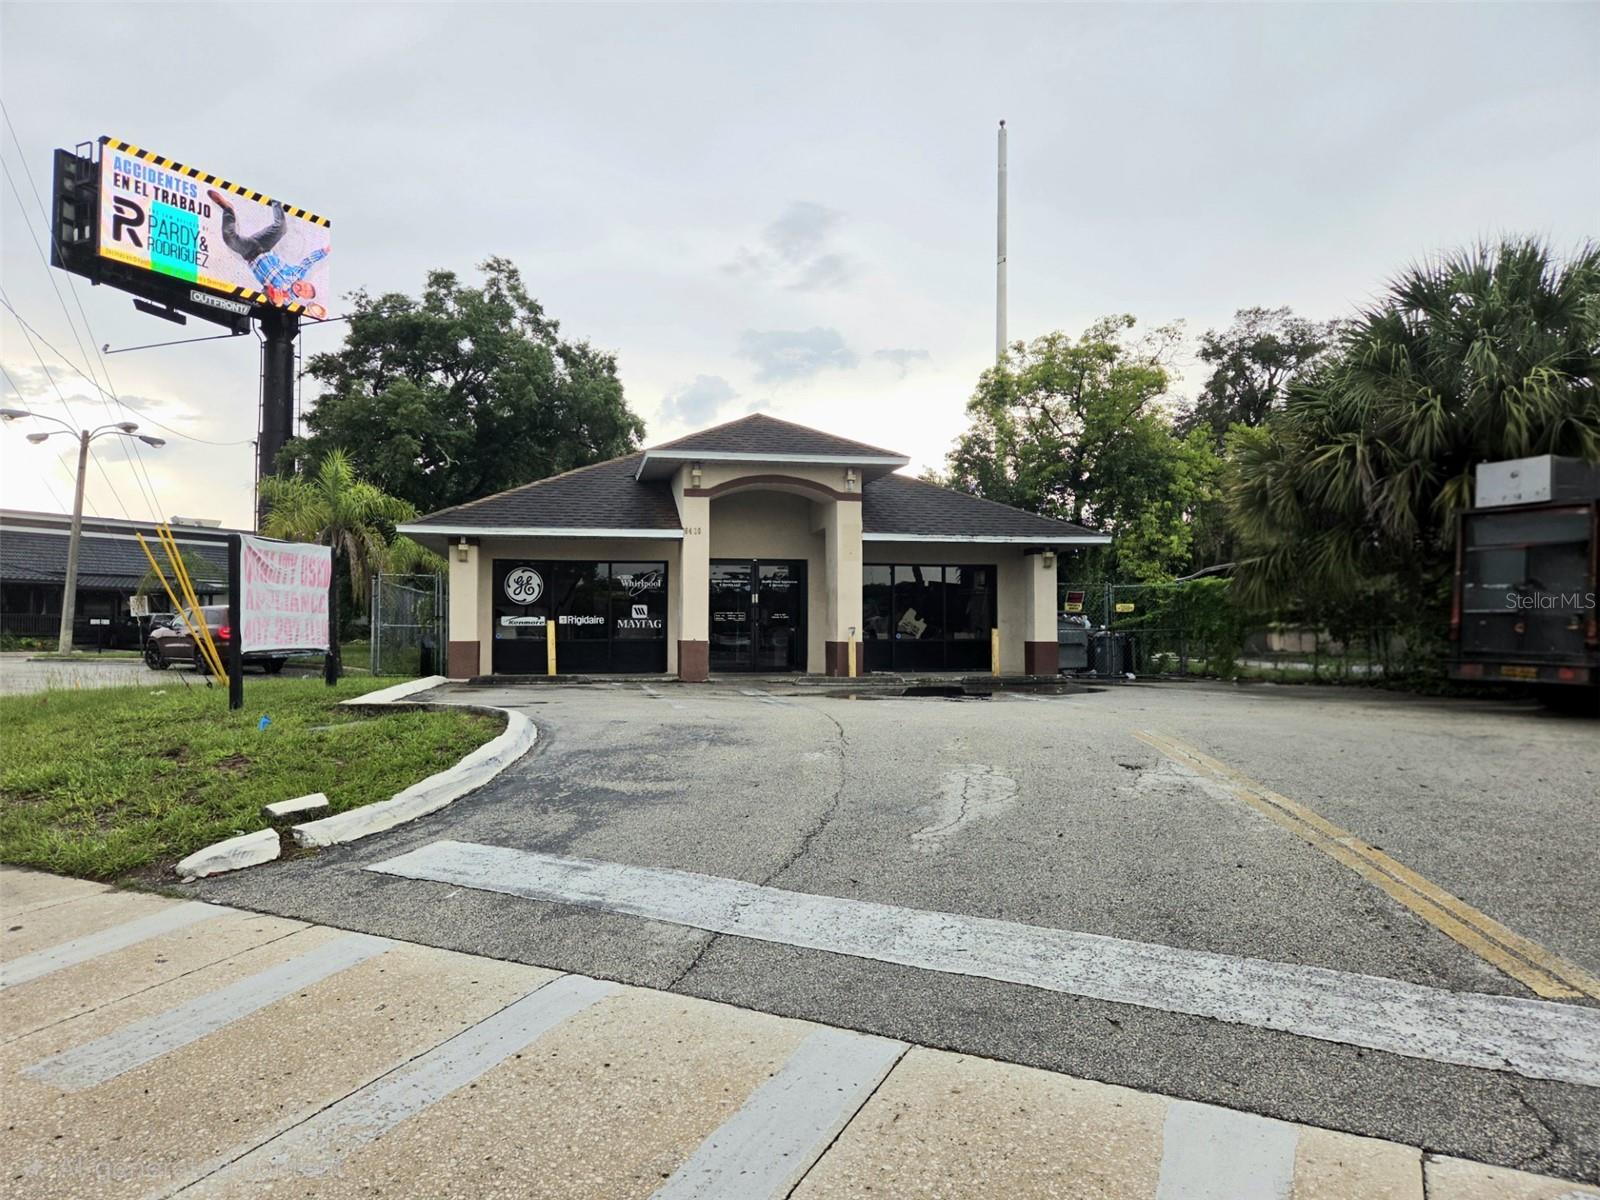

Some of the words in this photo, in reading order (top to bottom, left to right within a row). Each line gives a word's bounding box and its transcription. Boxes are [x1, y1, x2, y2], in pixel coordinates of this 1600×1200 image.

[113, 156, 197, 198] ACCIDENTES
[113, 172, 130, 191] EN
[134, 179, 149, 197] EL
[153, 186, 211, 219] TRABAJO
[147, 236, 209, 269] RODRIGUEZ
[301, 555, 331, 589] USED
[513, 575, 535, 596] GE
[618, 576, 661, 589] Whirlpool
[567, 615, 605, 626] Frigidaire
[617, 619, 662, 629] MAYTAG
